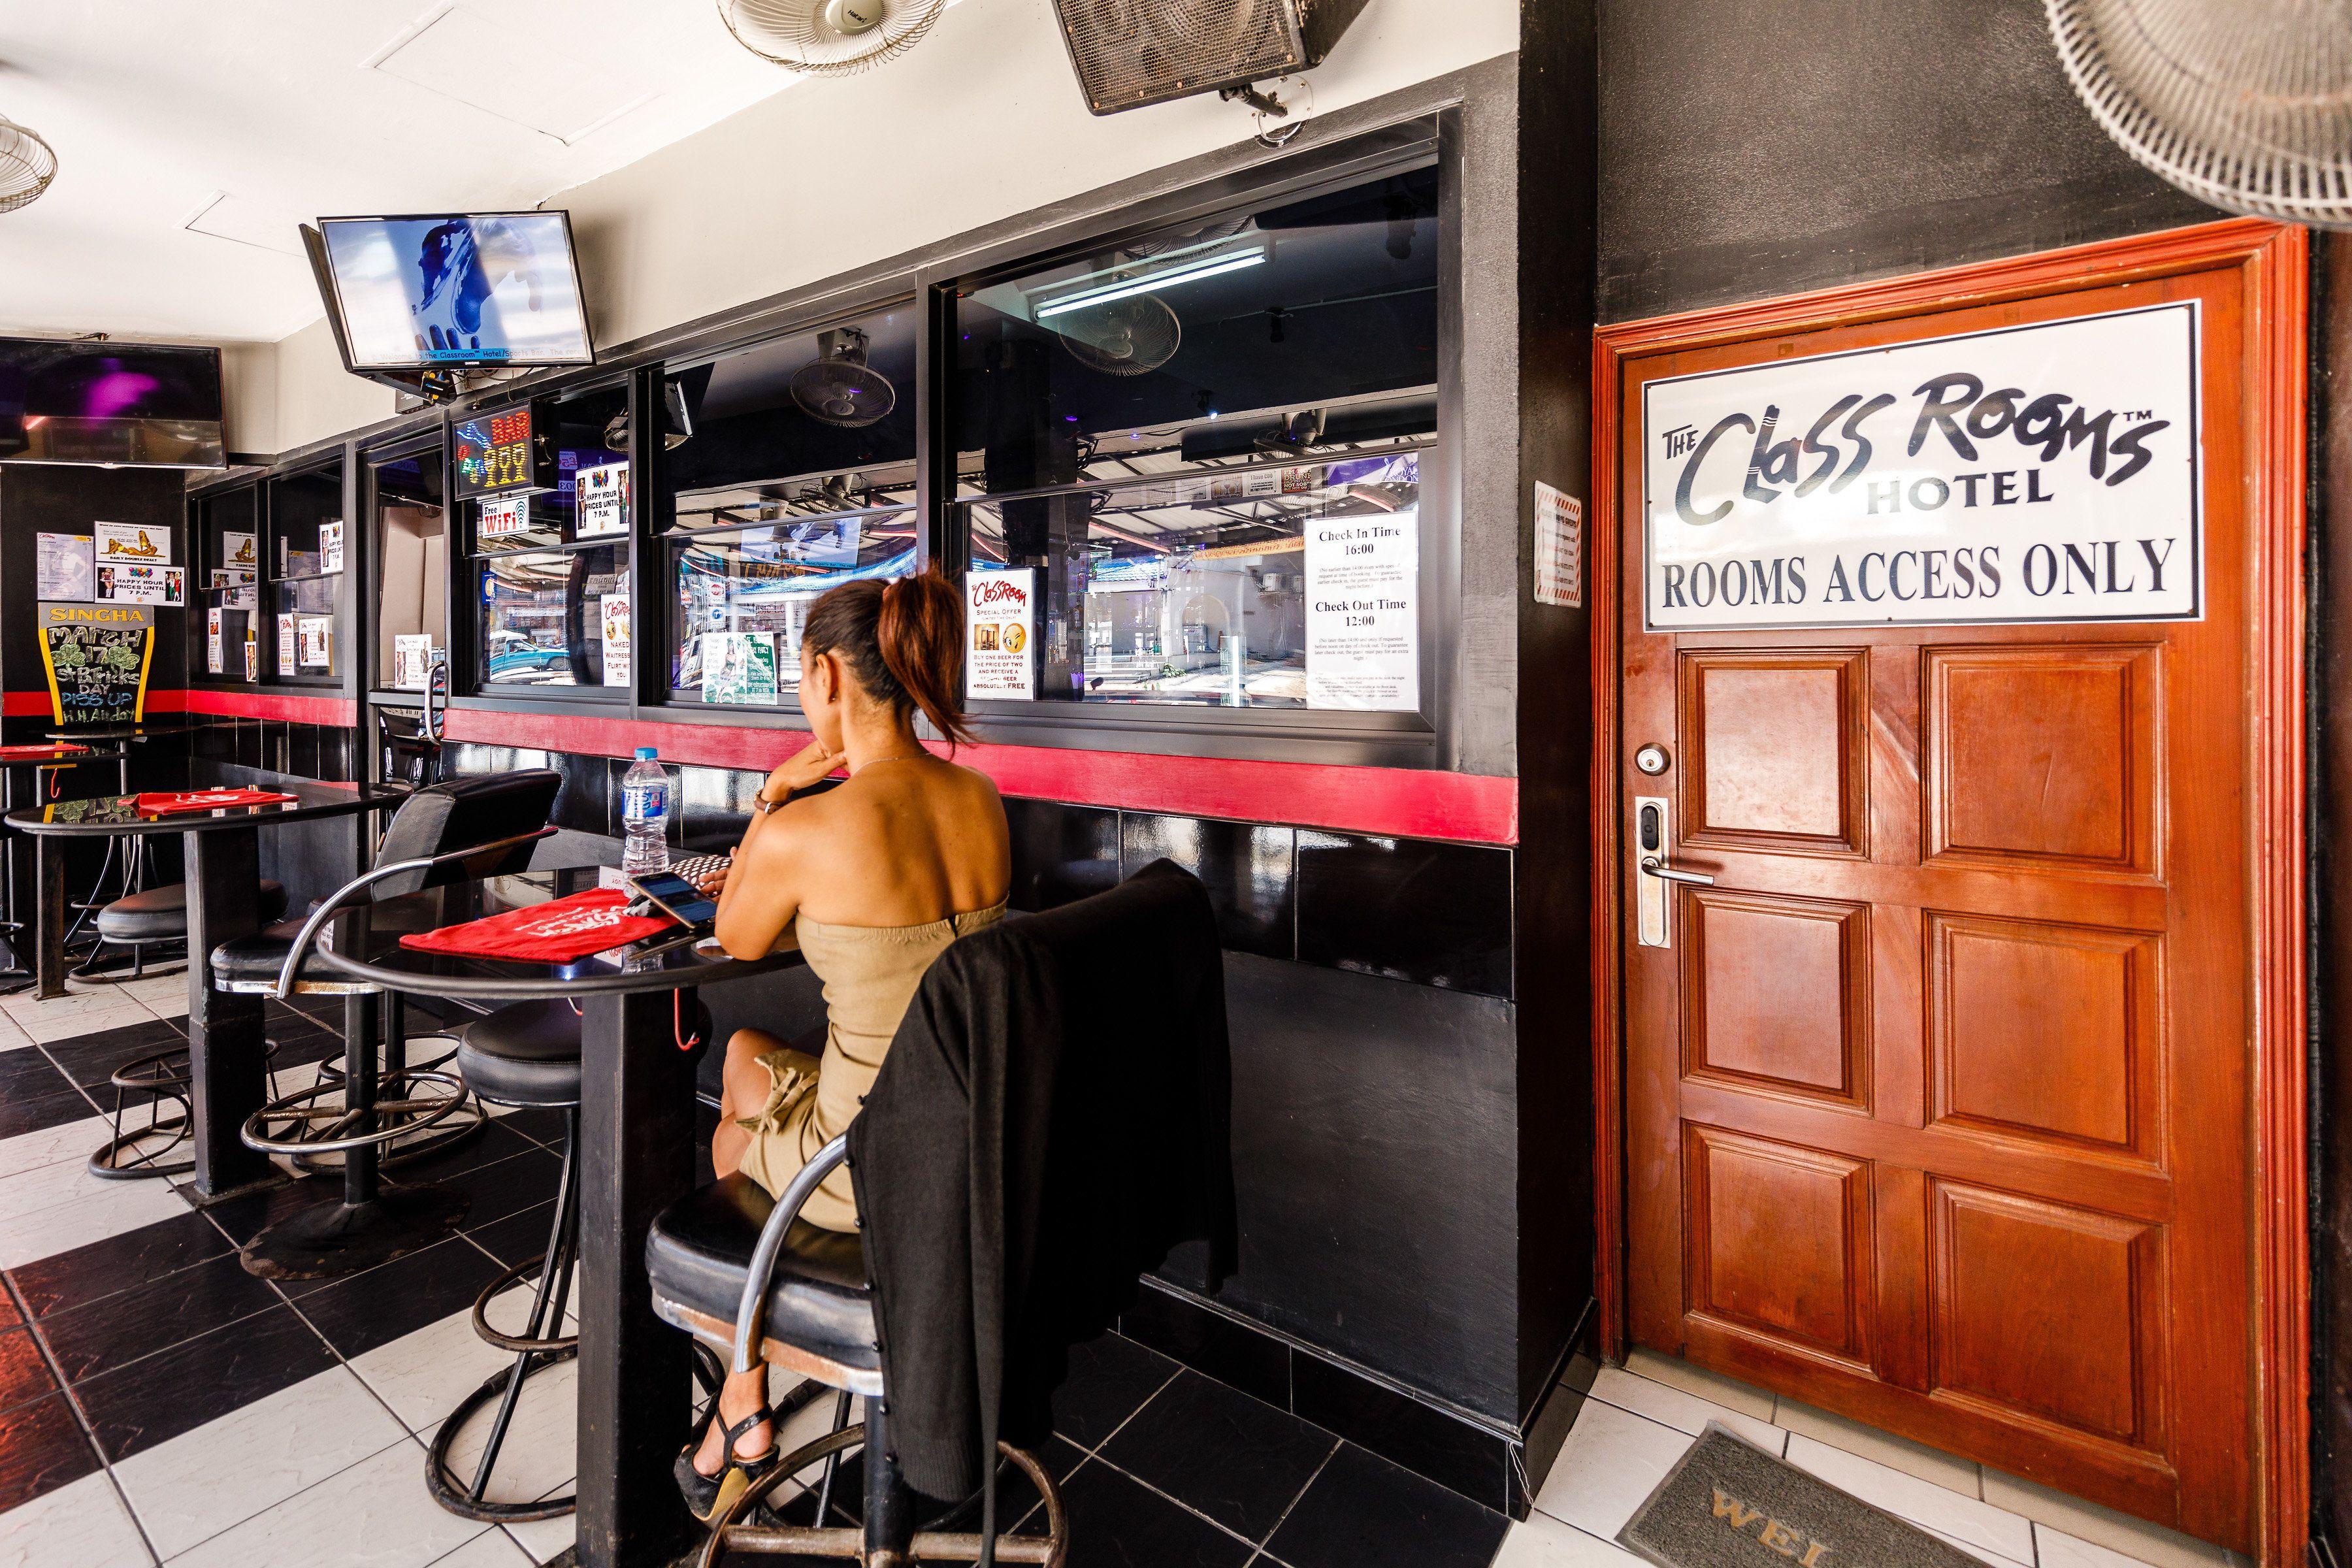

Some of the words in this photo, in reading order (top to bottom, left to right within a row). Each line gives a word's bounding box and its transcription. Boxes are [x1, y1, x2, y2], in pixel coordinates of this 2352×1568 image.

[847, 9, 868, 23] Hatari
[491, 411, 531, 446] BAR
[1662, 424, 1699, 460] THE
[587, 492, 601, 502] HAPPY
[602, 490, 617, 498] HOUR
[1867, 468, 2055, 515] HOTEL
[485, 506, 497, 515] Free
[586, 502, 602, 510] PRICES
[604, 499, 619, 508] UNTIL
[485, 512, 516, 534] WiFi
[1319, 530, 1352, 542] Check
[1357, 529, 1367, 538] In
[1371, 527, 1401, 538] Time
[1345, 544, 1374, 555] 16:00
[1662, 557, 1806, 608] ROOMS
[1823, 546, 2001, 603] ACCESS
[2023, 538, 2176, 596] ONLY
[1315, 601, 1348, 612] Check
[1352, 600, 1373, 611] Out
[1377, 599, 1407, 610] Time
[50, 608, 144, 622] SINGHA
[1346, 616, 1375, 627] 12:00
[86, 645, 108, 664] 17
[79, 684, 110, 695] DAY
[61, 692, 103, 707] PISS
[107, 693, 133, 706] UP
